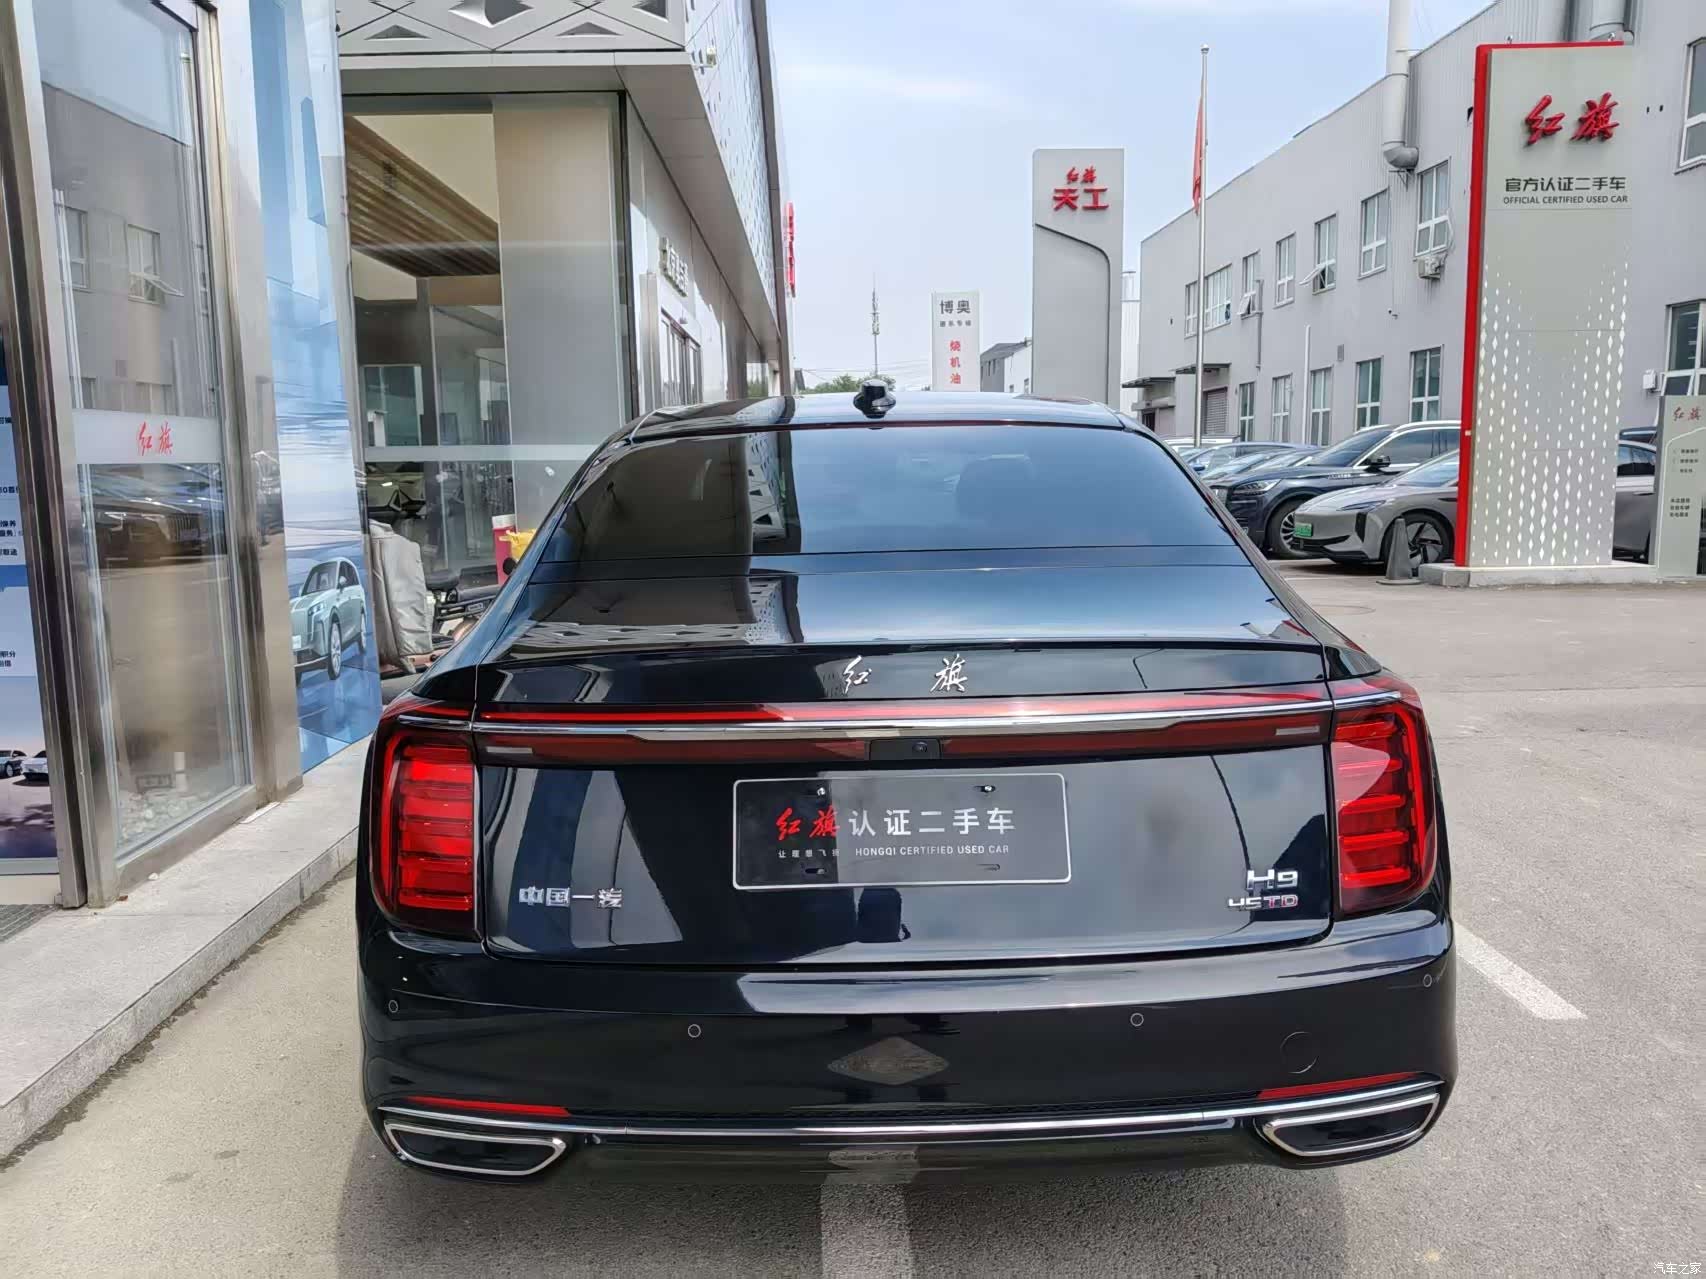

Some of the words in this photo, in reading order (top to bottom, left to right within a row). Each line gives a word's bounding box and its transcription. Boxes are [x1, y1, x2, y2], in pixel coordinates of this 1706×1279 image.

[1524, 92, 1619, 145] 红旗
[1066, 166, 1097, 184] 红旗
[1505, 176, 1626, 192] 官方认证二手车
[1053, 188, 1109, 211] 天工
[1503, 196, 1539, 204] OFFICIAL
[1542, 196, 1584, 204] CERTIFIED
[1586, 196, 1609, 204] USED
[1611, 195, 1628, 203] CAR
[939, 300, 971, 314] 博奥
[1673, 407, 1702, 421] 红旗
[136, 421, 173, 456] 红旗
[843, 653, 968, 694] 红旗
[855, 847, 896, 857] HONGQI
[899, 846, 953, 856] CERTIFIED
[957, 845, 985, 855] USED
[988, 844, 1009, 854] CAR
[1246, 868, 1298, 890] H9
[519, 886, 622, 908] 中国一汽
